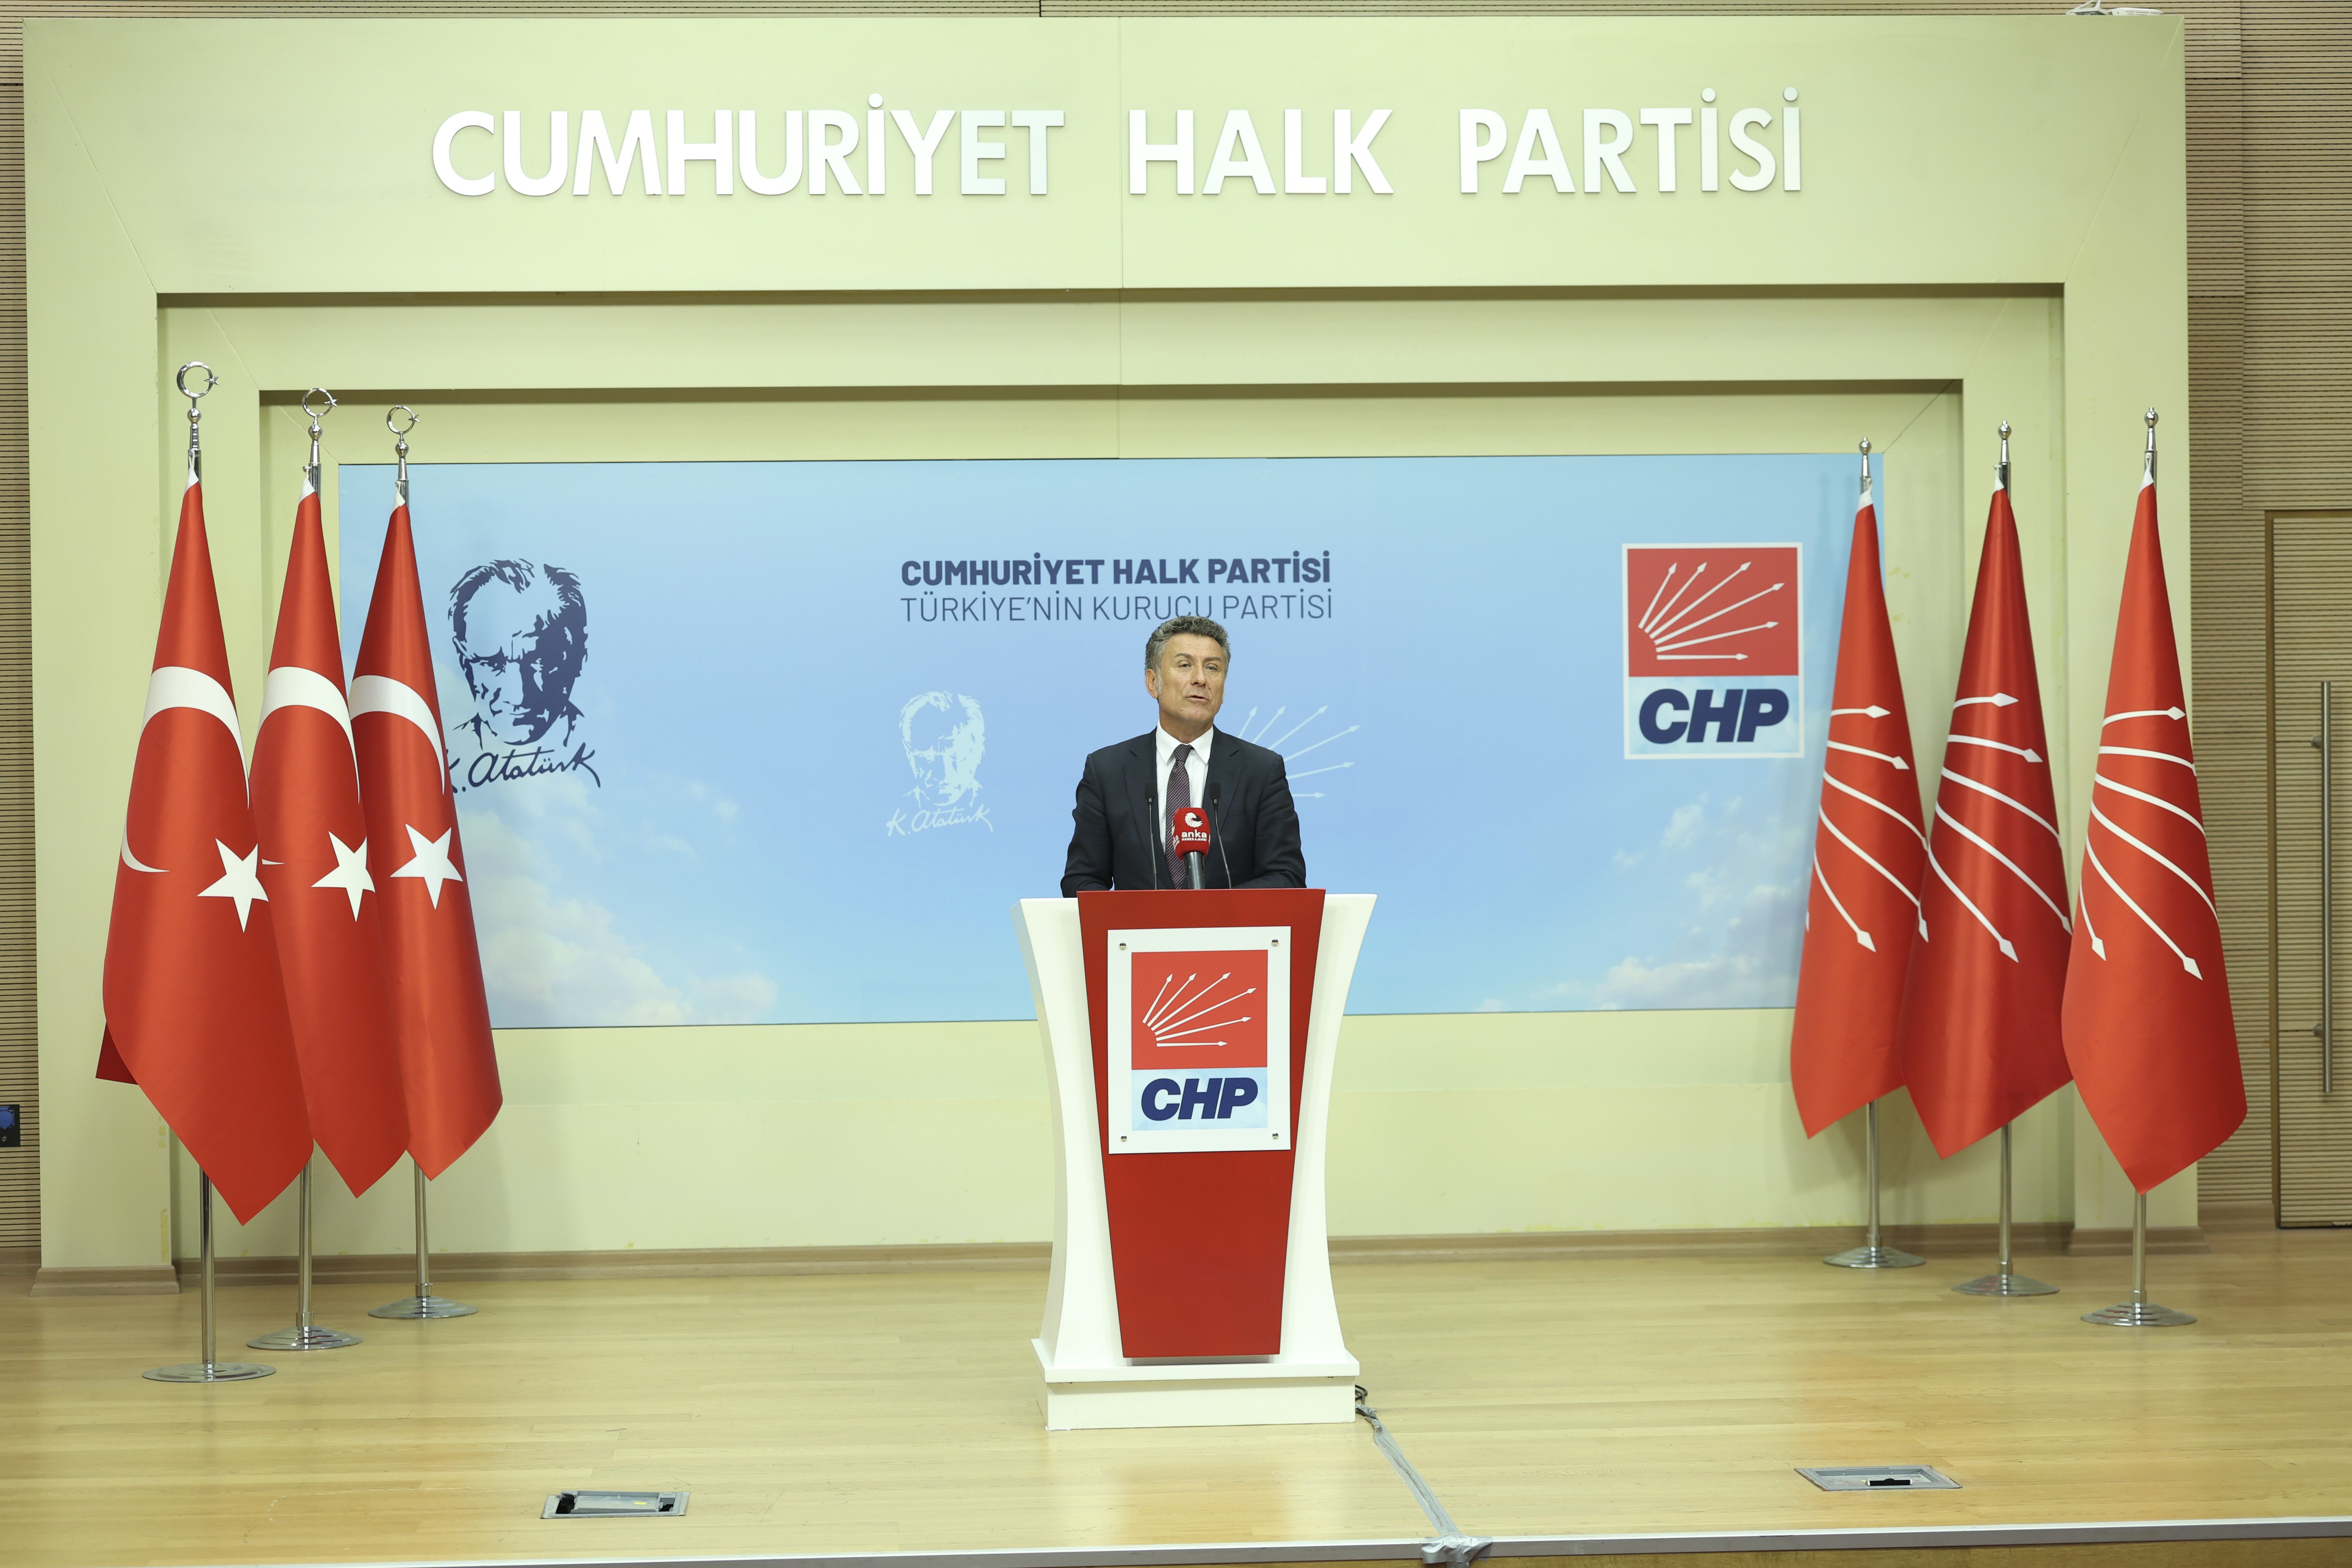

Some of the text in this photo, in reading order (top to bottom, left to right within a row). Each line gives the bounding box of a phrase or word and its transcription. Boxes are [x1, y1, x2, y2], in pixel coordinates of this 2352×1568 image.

[432, 88, 1801, 197] CUMHURİYET HALK PARTİSİ
[901, 550, 1330, 586] CUMHURİYET HALK PARTİSİ
[1094, 595, 1212, 621] KURUCU
[1223, 588, 1332, 619] PARTİSİ
[1638, 688, 1789, 744] CHP
[1181, 829, 1207, 838] anka
[1141, 1077, 1258, 1121] CHP
